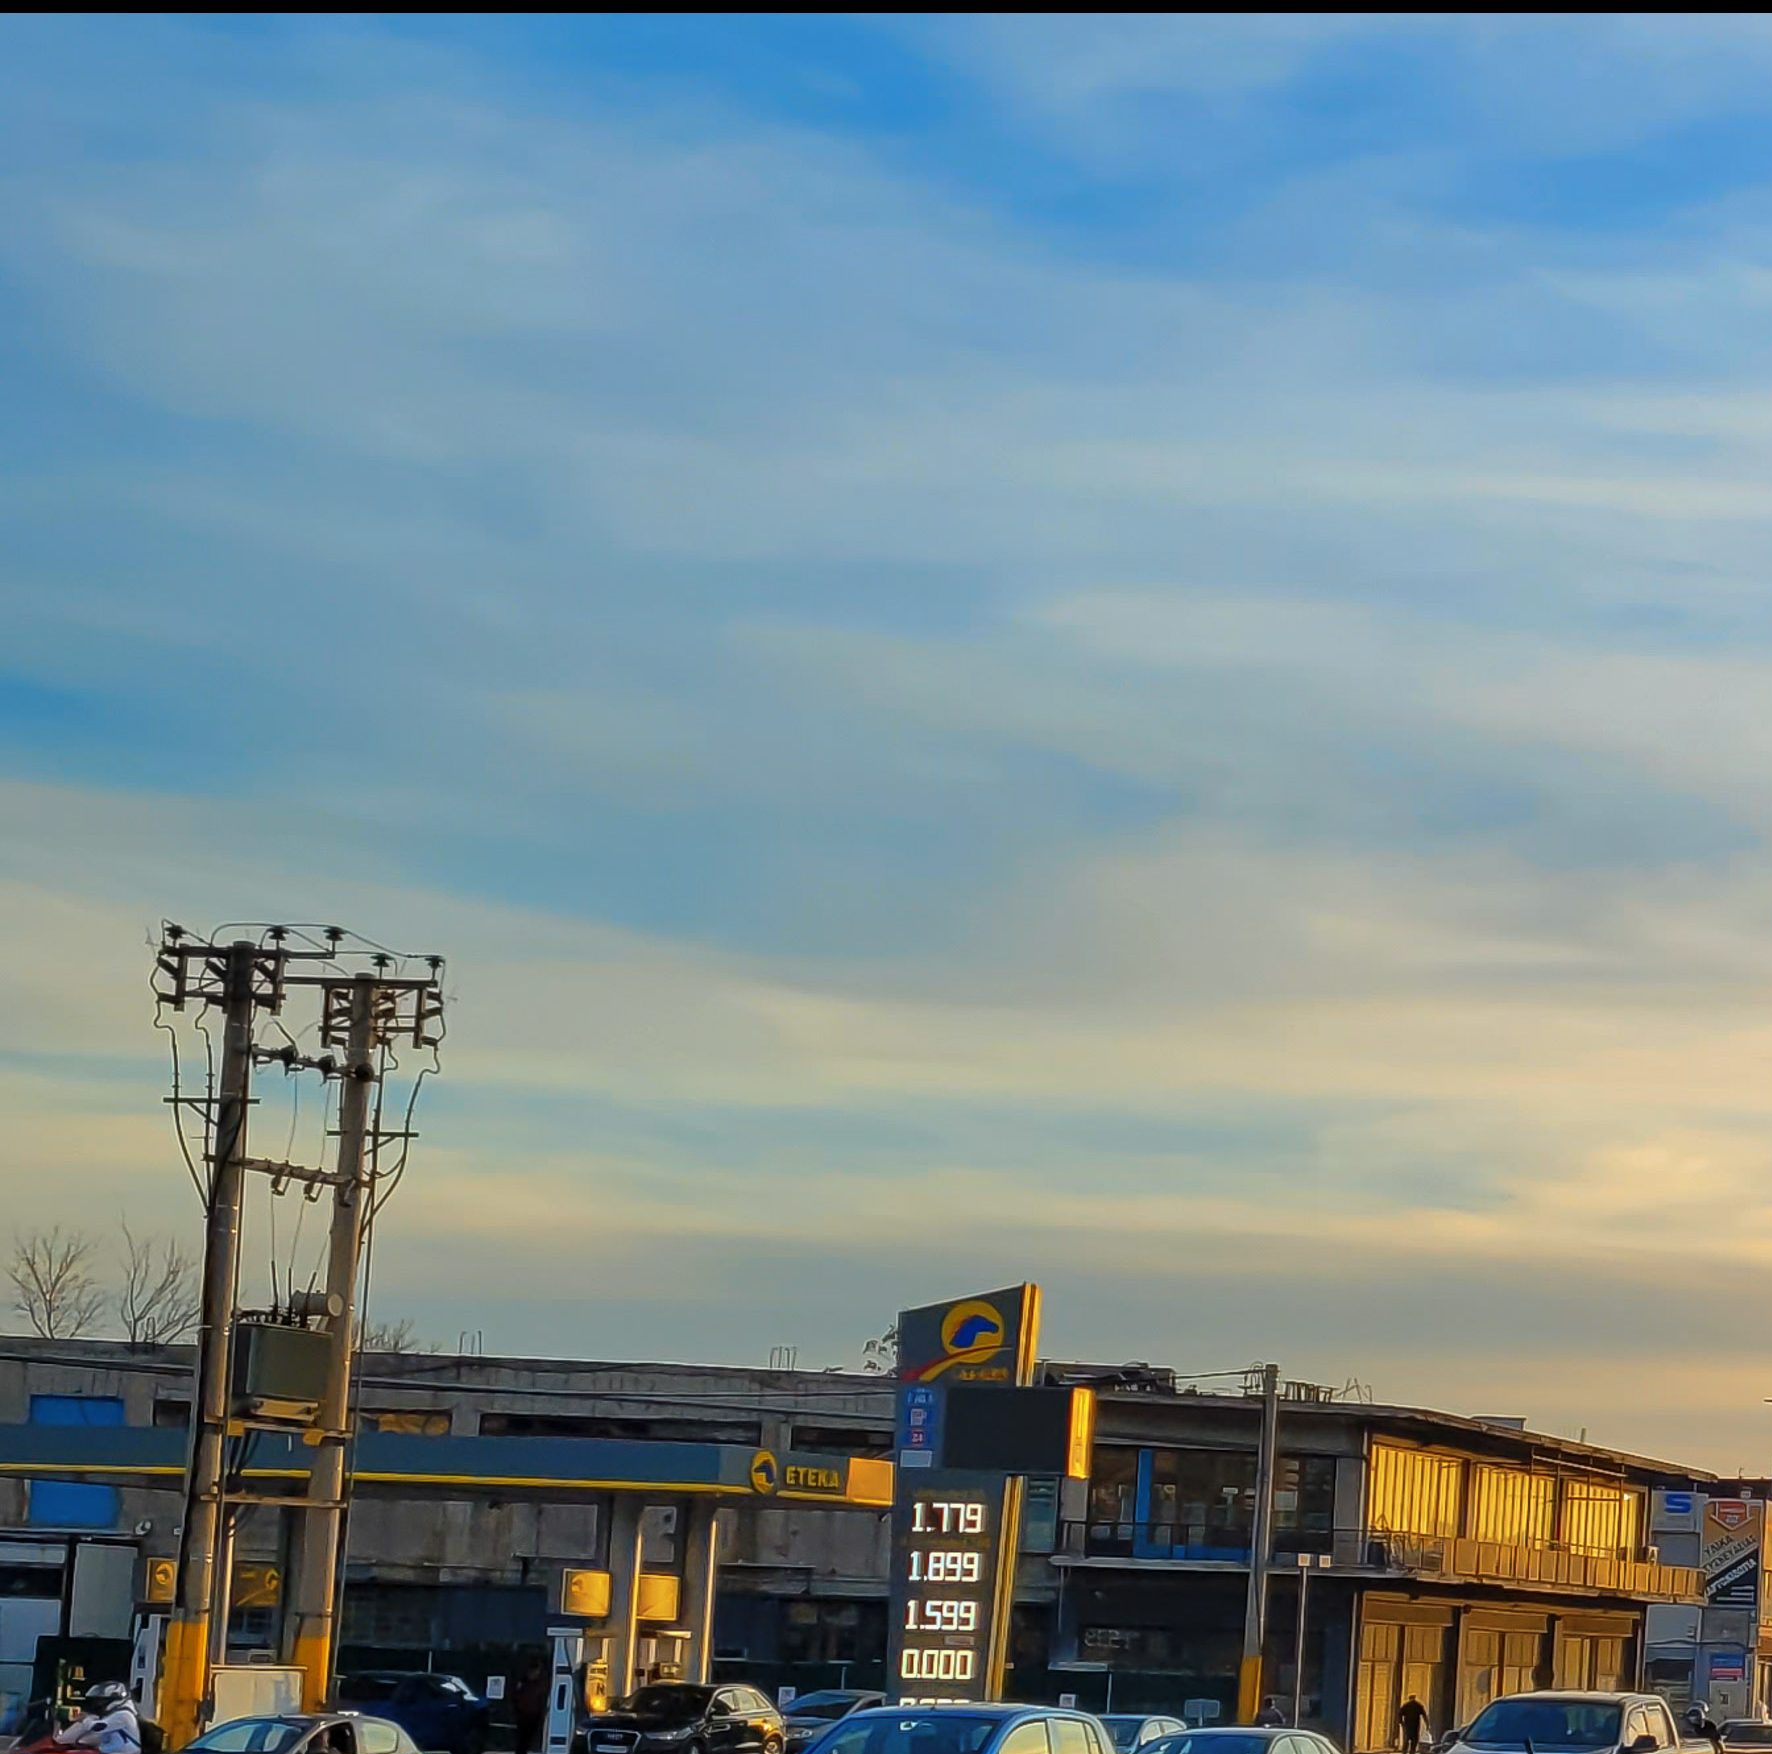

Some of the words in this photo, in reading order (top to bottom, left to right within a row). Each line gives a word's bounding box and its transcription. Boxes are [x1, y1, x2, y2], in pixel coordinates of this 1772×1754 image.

[912, 1502, 985, 1534] 1.779
[908, 1551, 981, 1583] 1.899
[905, 1600, 977, 1630] 1.599
[901, 1649, 973, 1680] 0.000
